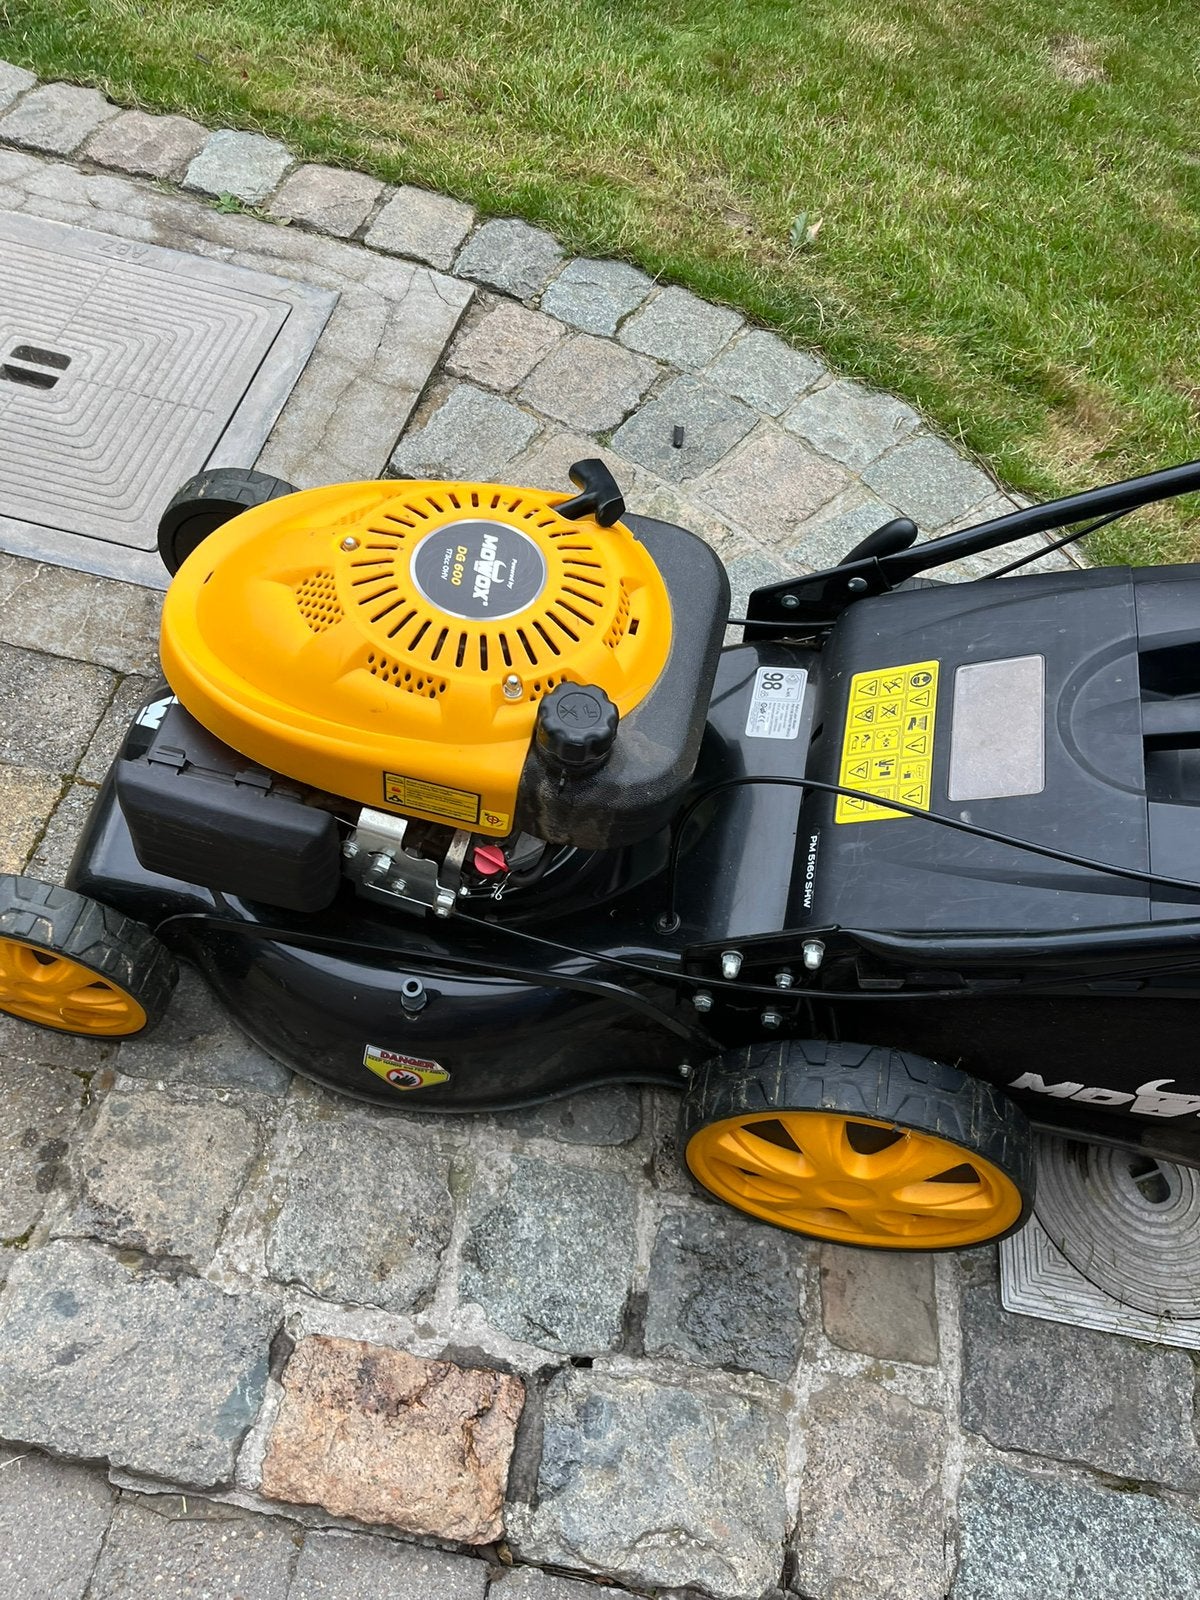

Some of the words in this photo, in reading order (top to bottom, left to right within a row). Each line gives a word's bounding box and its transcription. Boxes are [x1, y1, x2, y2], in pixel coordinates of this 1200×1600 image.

[444, 548, 453, 565] 173cc
[455, 545, 468, 562] DG
[440, 564, 450, 580] OHV
[450, 563, 465, 586] 600
[508, 558, 518, 582] Powered
[506, 580, 514, 591] by
[761, 672, 784, 690] 98
[808, 835, 818, 852] PM
[805, 854, 816, 880] 5160
[803, 881, 813, 908] SHW
[380, 1050, 435, 1069] DANGER
[383, 1059, 403, 1067] HANDS
[1007, 1072, 1200, 1118] MOW
